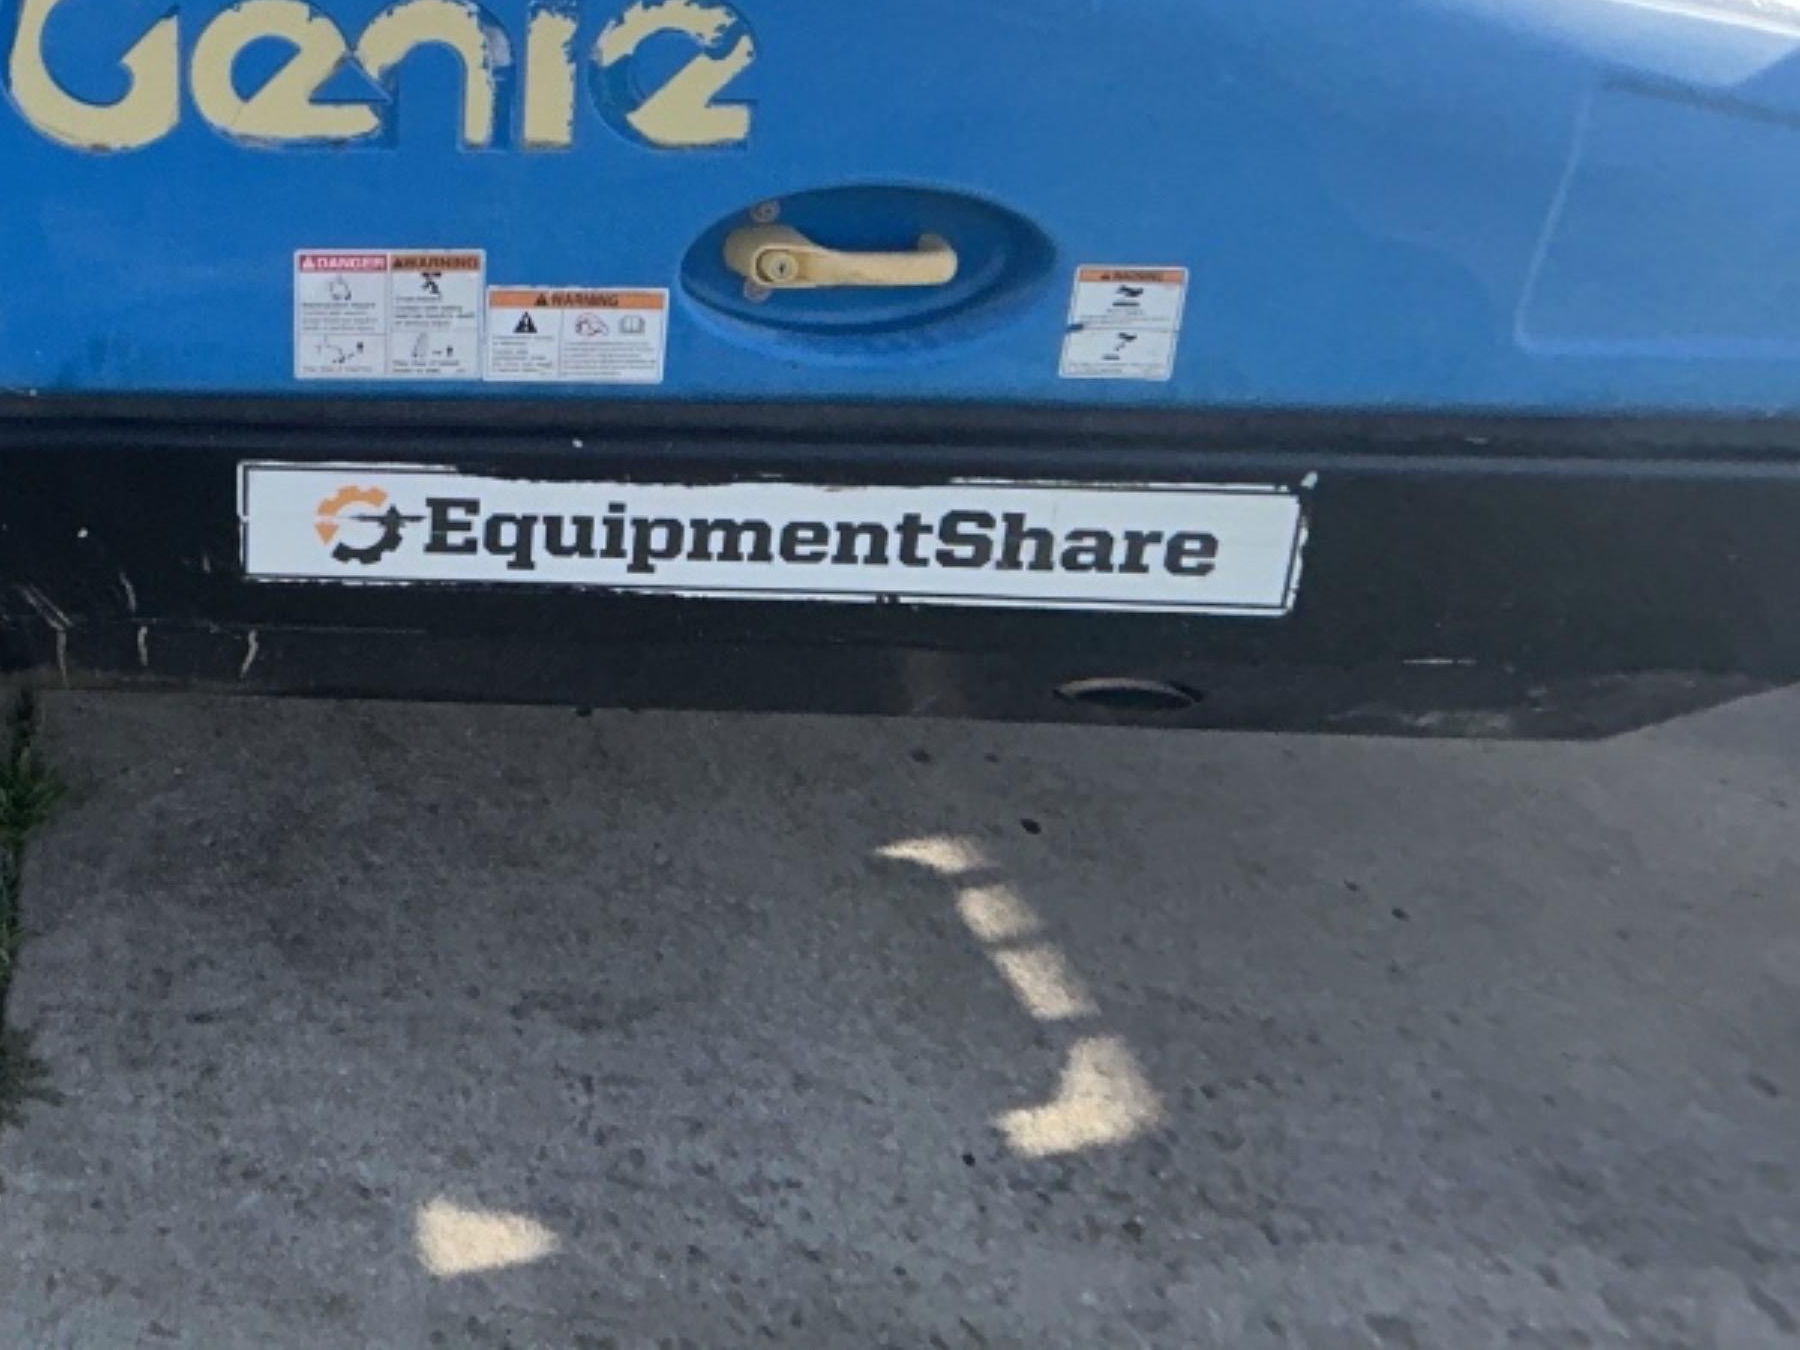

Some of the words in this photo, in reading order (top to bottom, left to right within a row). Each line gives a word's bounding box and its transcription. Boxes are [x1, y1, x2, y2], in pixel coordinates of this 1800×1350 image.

[316, 255, 385, 270] DANGER
[551, 293, 620, 308] WARNING
[423, 496, 1220, 577] EquipmentShare
